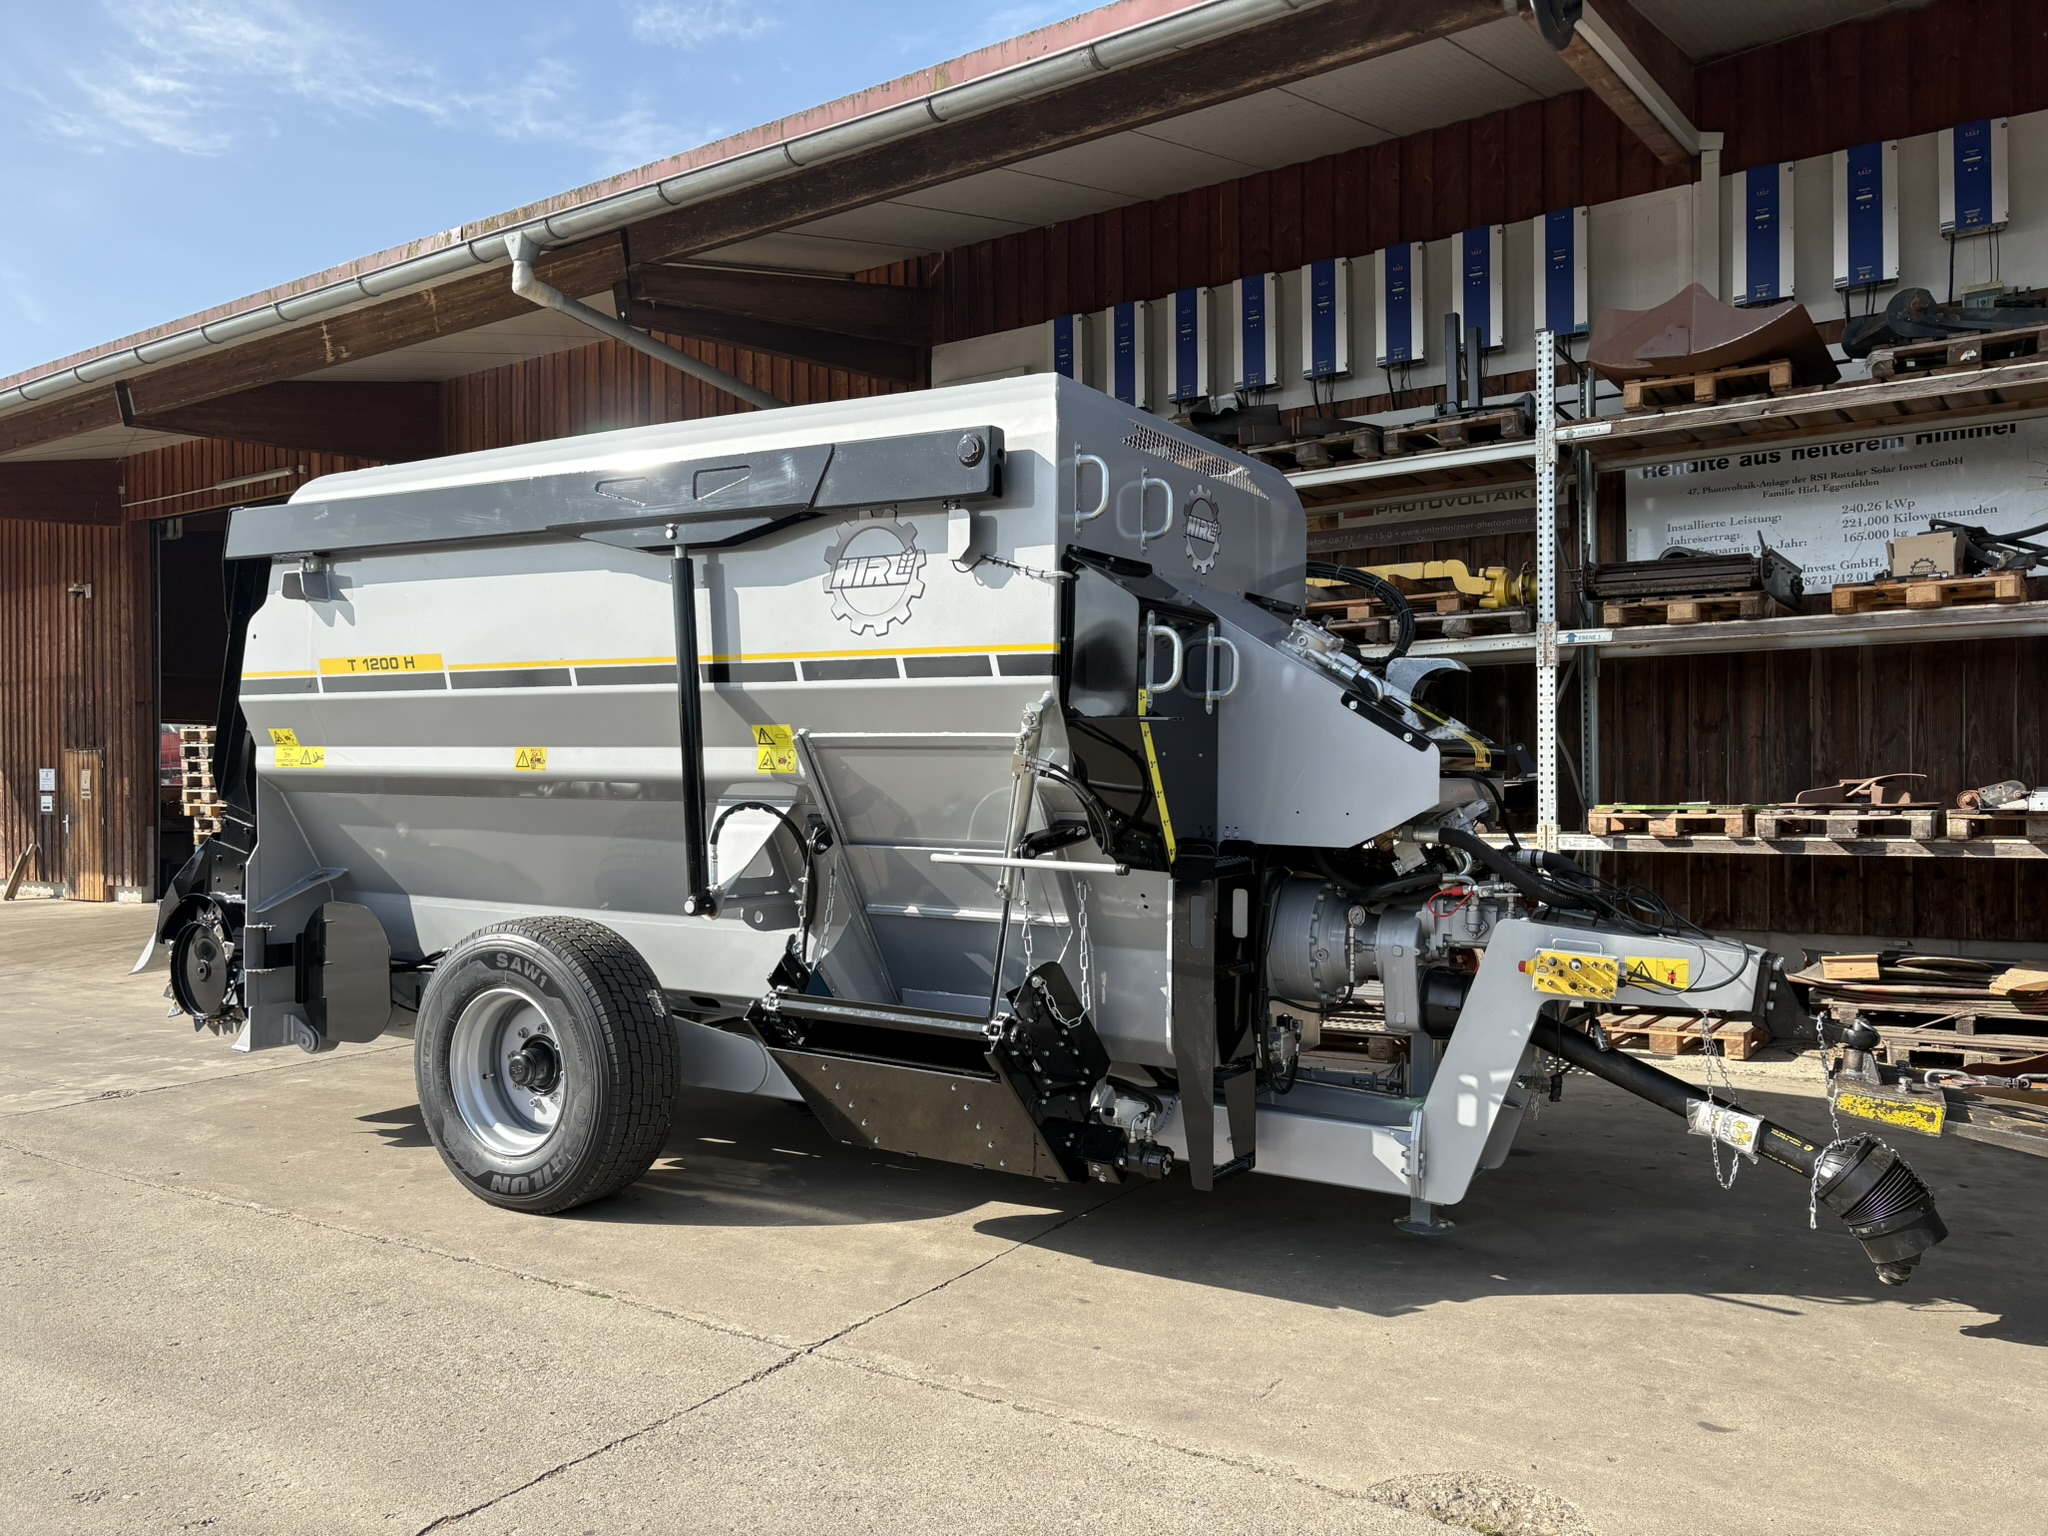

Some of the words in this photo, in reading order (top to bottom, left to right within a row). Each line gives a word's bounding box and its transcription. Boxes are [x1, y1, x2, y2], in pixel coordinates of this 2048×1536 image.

[1739, 450, 1781, 468] aus
[1702, 477, 1790, 496] Photovoltaik-Anlage
[1792, 475, 1807, 485] der
[1810, 472, 1827, 483] RSI
[1830, 468, 1868, 482] Rottaler
[1870, 464, 1896, 475] Solar
[1899, 461, 1928, 472] Invest
[1930, 456, 1964, 469] GmbH
[1763, 487, 1796, 499] Familie
[1798, 484, 1820, 496] Hirl,
[1823, 478, 1880, 493] Eggenfelden
[1376, 488, 1528, 516] PHOTOVOLTAIK
[1667, 518, 1727, 533] Installierte
[1729, 514, 1782, 527] Leistung:
[1885, 499, 1916, 511] kWp
[1185, 515, 1219, 545] HIRL
[1400, 515, 1537, 537] www.unterholzner-photovoltaik.d
[1667, 532, 1740, 546] Jahresertrag:
[1842, 514, 1889, 529] 221.000
[1893, 504, 1998, 524] Kilowattstunden
[1753, 543, 1773, 555] po
[1776, 538, 1808, 549] Jahr:
[1843, 529, 1890, 543] 165.000
[1893, 528, 1909, 538] kg
[830, 547, 918, 590] HIRL
[1802, 563, 1840, 573] Invest
[1840, 557, 1883, 570] GmbH,
[347, 659, 357, 671] T
[362, 657, 399, 670] 1200
[404, 656, 416, 669] H
[495, 952, 548, 988] SAW1
[422, 1029, 433, 1090] WINTER
[489, 1129, 582, 1194] SAILUN
